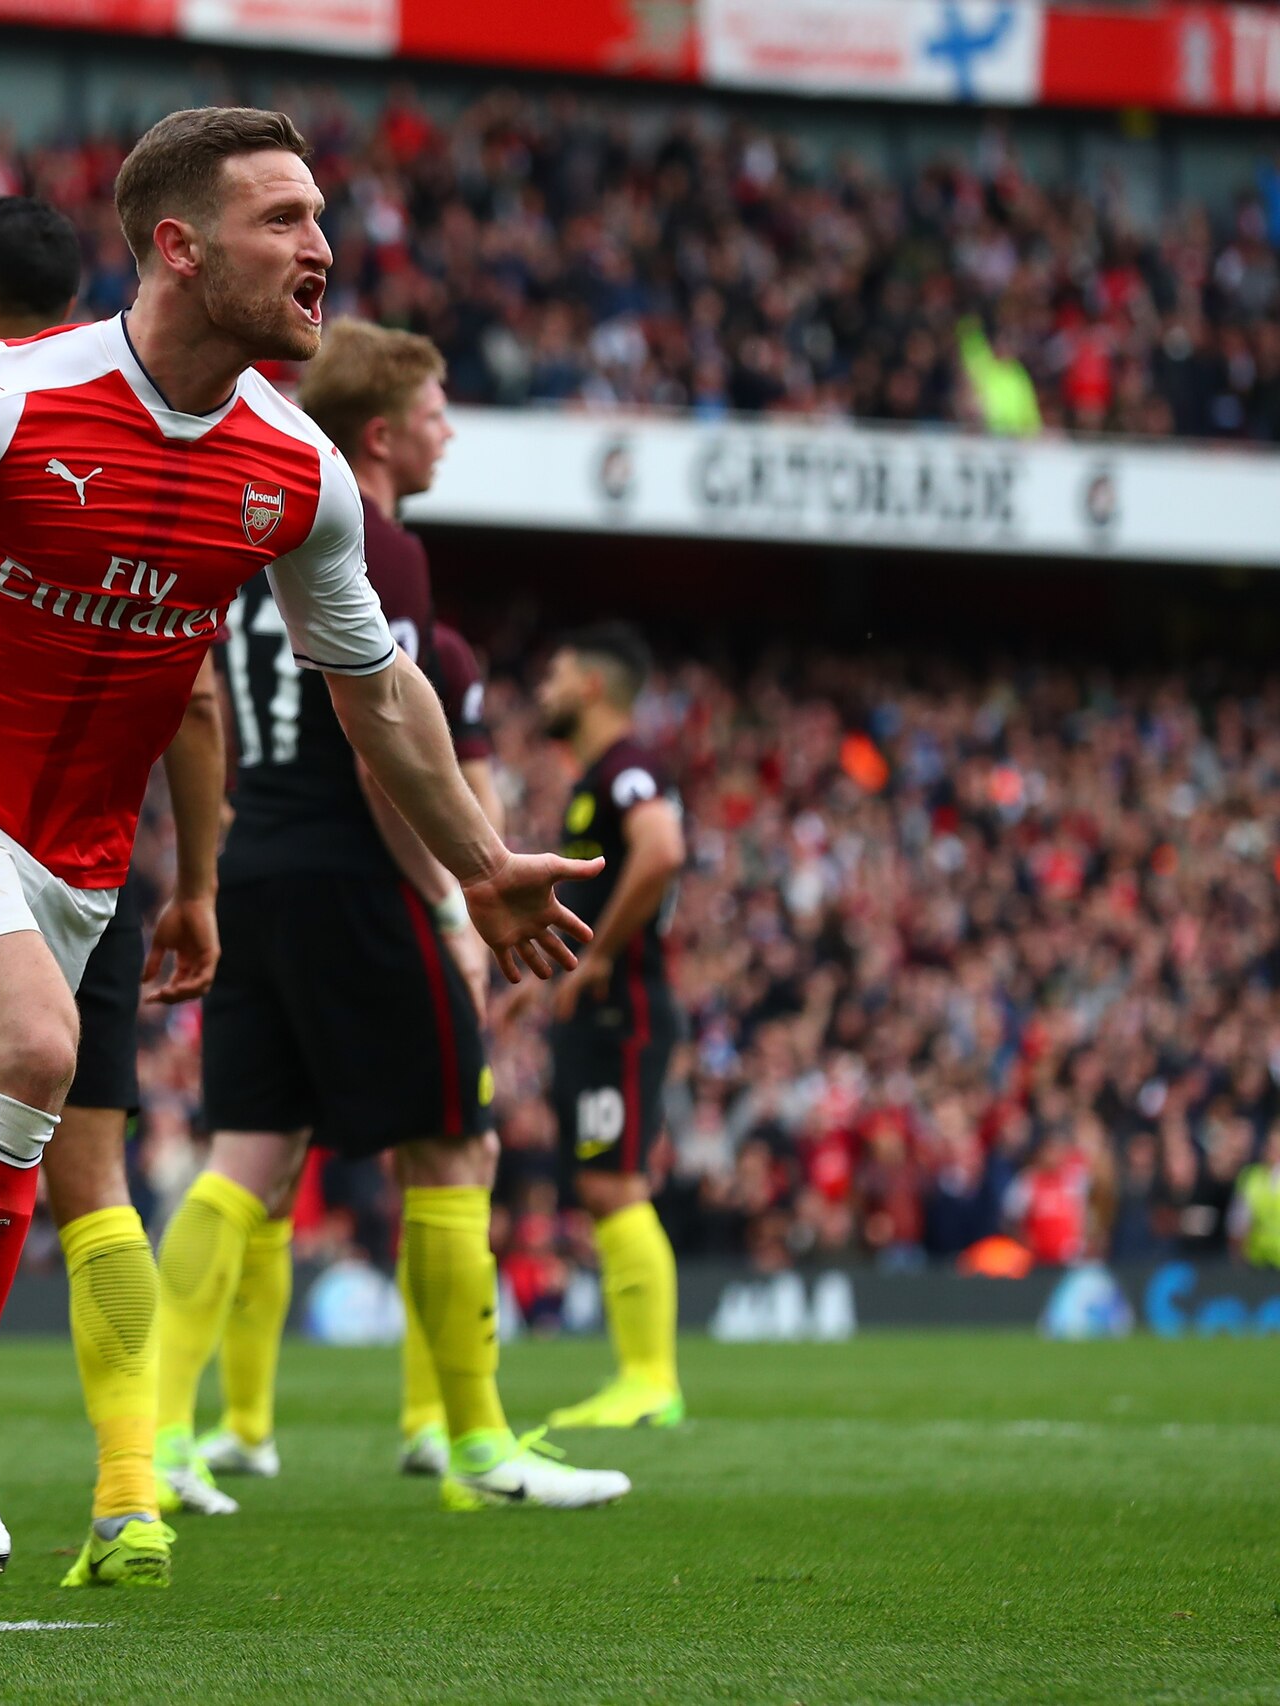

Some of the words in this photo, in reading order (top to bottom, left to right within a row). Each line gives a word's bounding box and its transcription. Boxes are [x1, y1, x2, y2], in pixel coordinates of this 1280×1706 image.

[248, 490, 280, 505] Arsenal
[101, 555, 178, 605] Fly
[576, 1086, 625, 1142] 10
